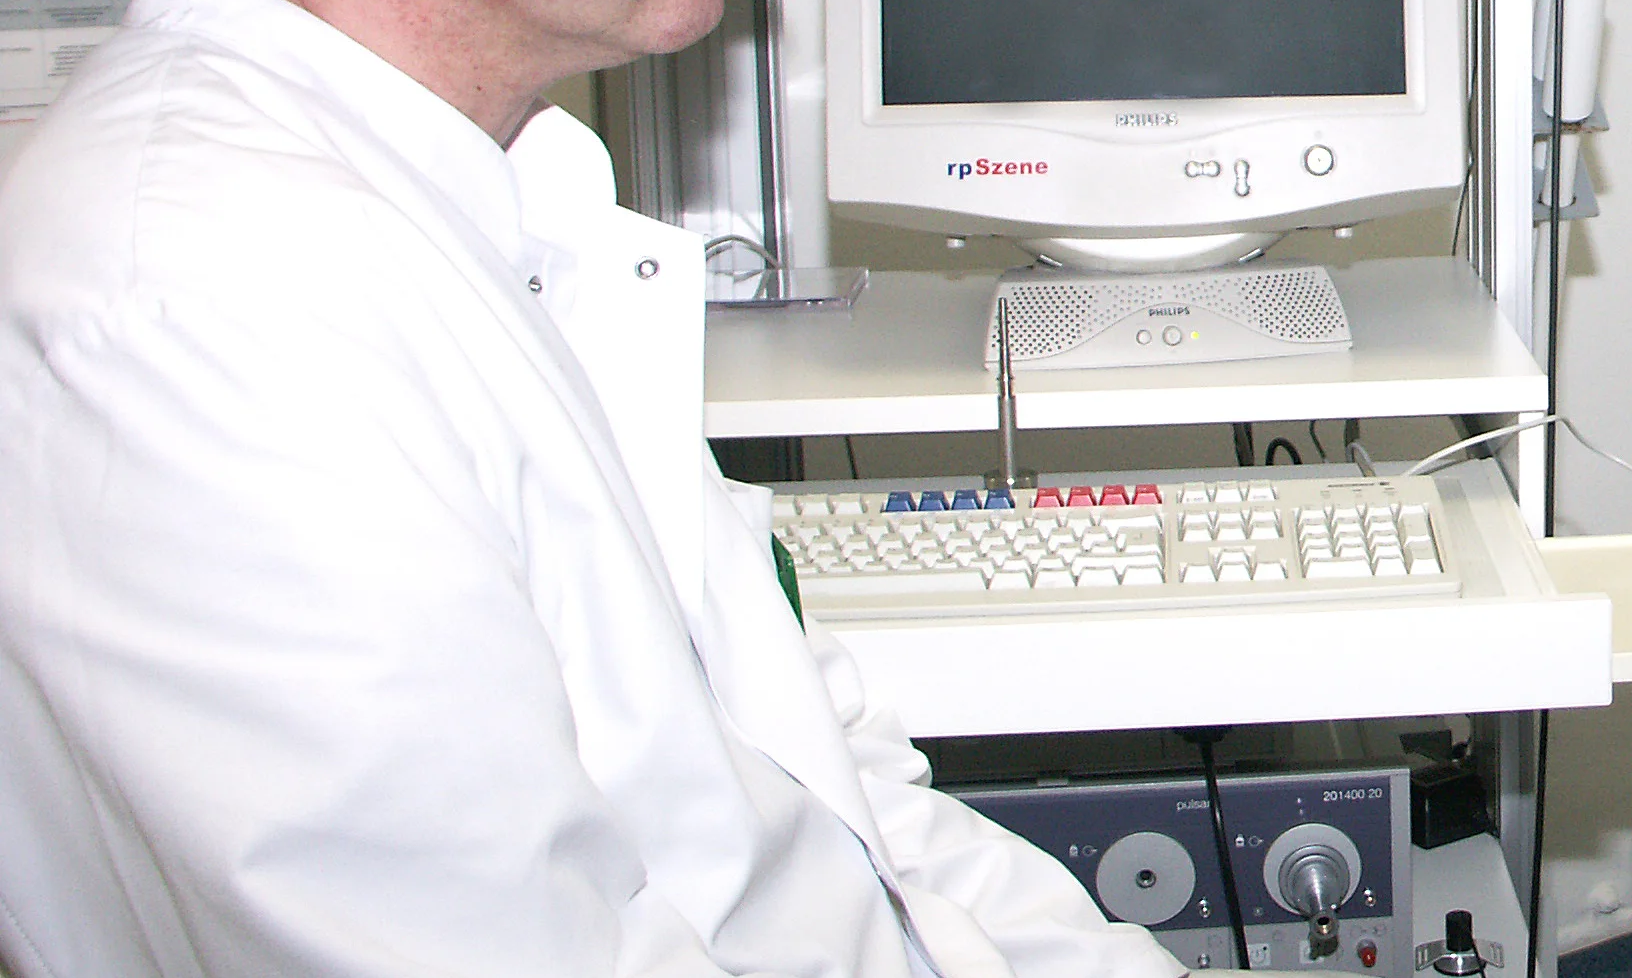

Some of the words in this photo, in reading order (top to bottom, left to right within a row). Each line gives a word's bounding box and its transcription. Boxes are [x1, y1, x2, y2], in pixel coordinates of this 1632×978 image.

[1115, 110, 1179, 127] PHILIPS
[947, 158, 1048, 179] rpSzene
[1148, 306, 1190, 317] PHILIPS
[1323, 789, 1365, 803] 201400
[1367, 787, 1383, 800] 20
